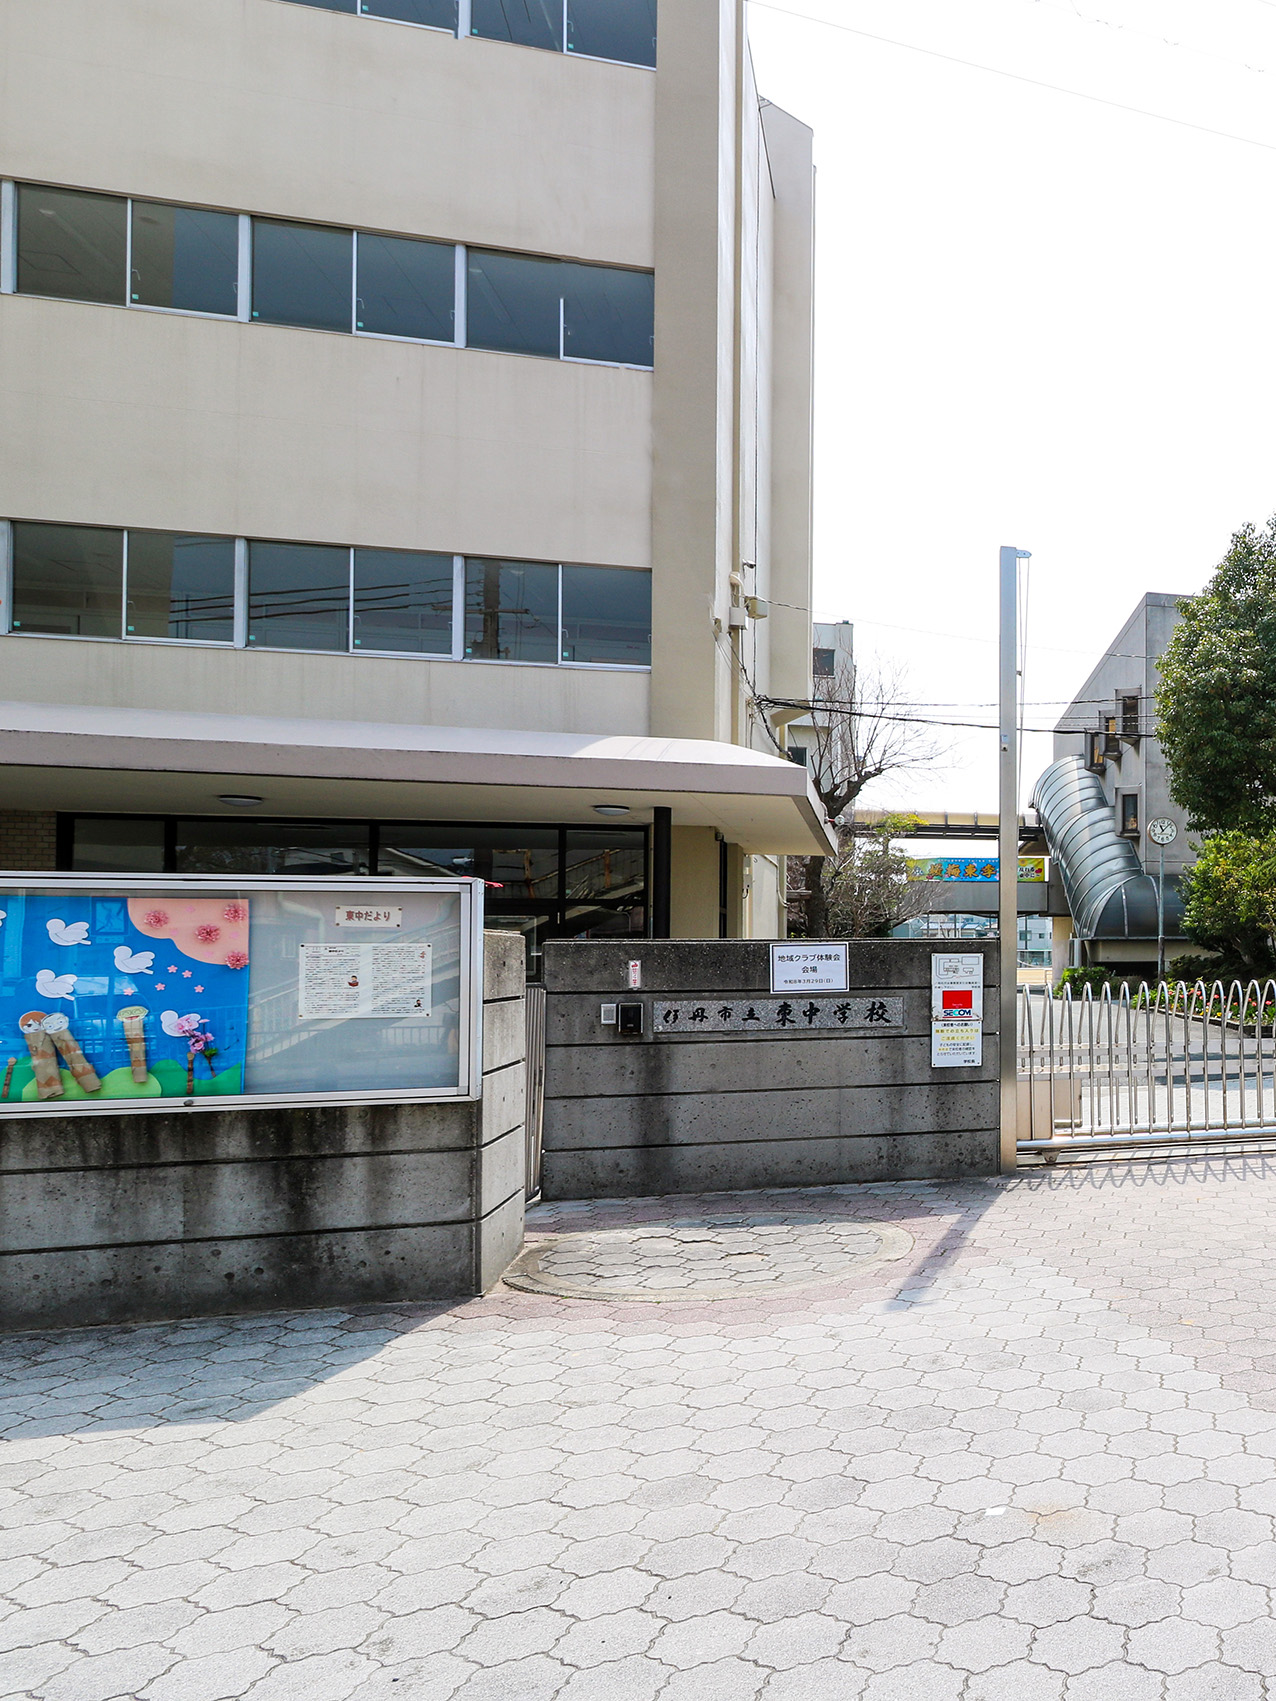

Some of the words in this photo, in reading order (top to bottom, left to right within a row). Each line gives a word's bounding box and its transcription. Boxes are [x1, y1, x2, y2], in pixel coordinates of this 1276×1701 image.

[345, 910, 391, 922] 東中だより
[777, 953, 841, 963] 地域クラブ体験会
[801, 965, 818, 974] 会場
